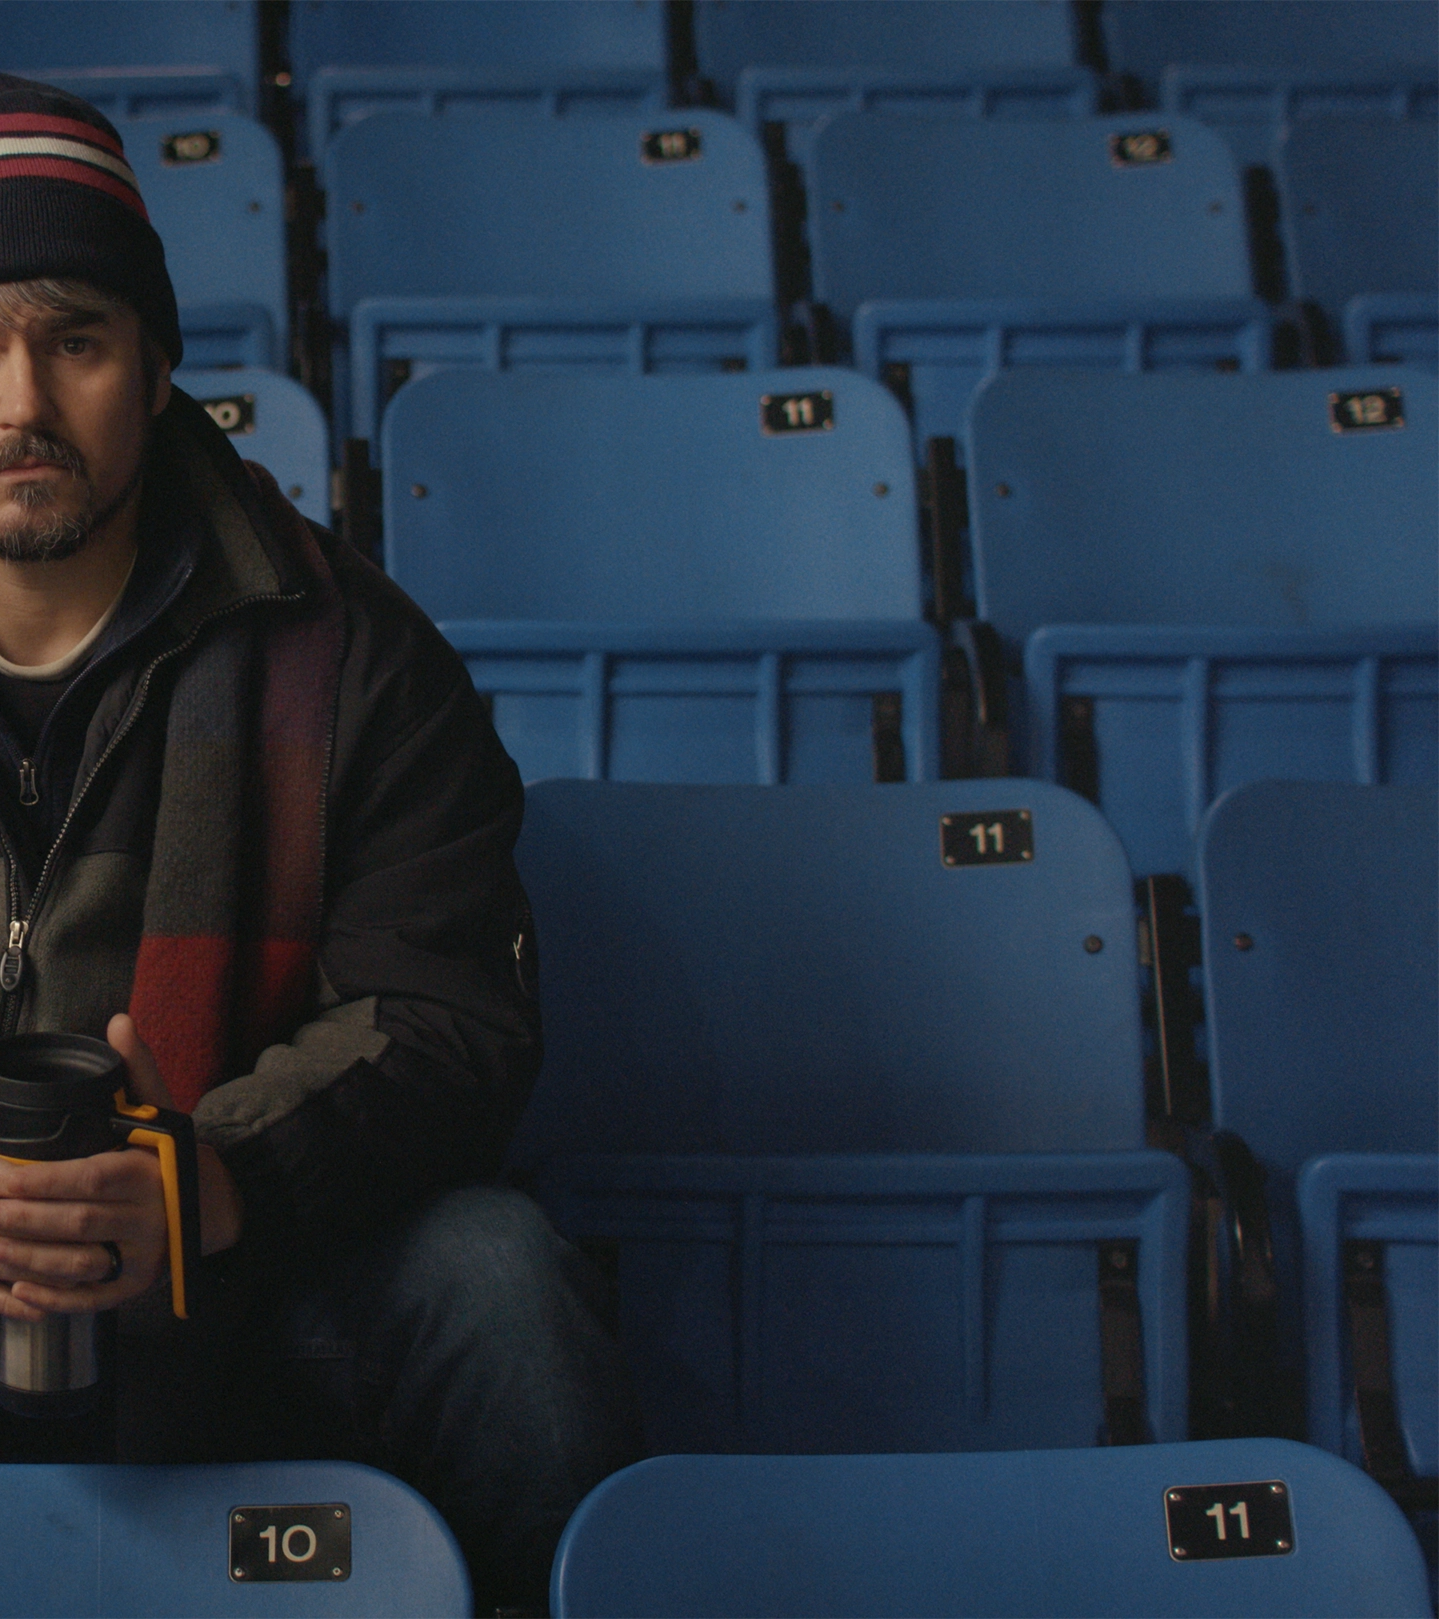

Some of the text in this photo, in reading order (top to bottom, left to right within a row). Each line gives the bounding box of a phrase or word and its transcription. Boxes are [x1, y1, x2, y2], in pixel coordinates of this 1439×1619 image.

[782, 398, 813, 426] 11
[1345, 395, 1388, 424] 12
[968, 823, 1005, 854] 11
[1205, 1500, 1251, 1541] 11
[258, 1523, 318, 1564] 10
